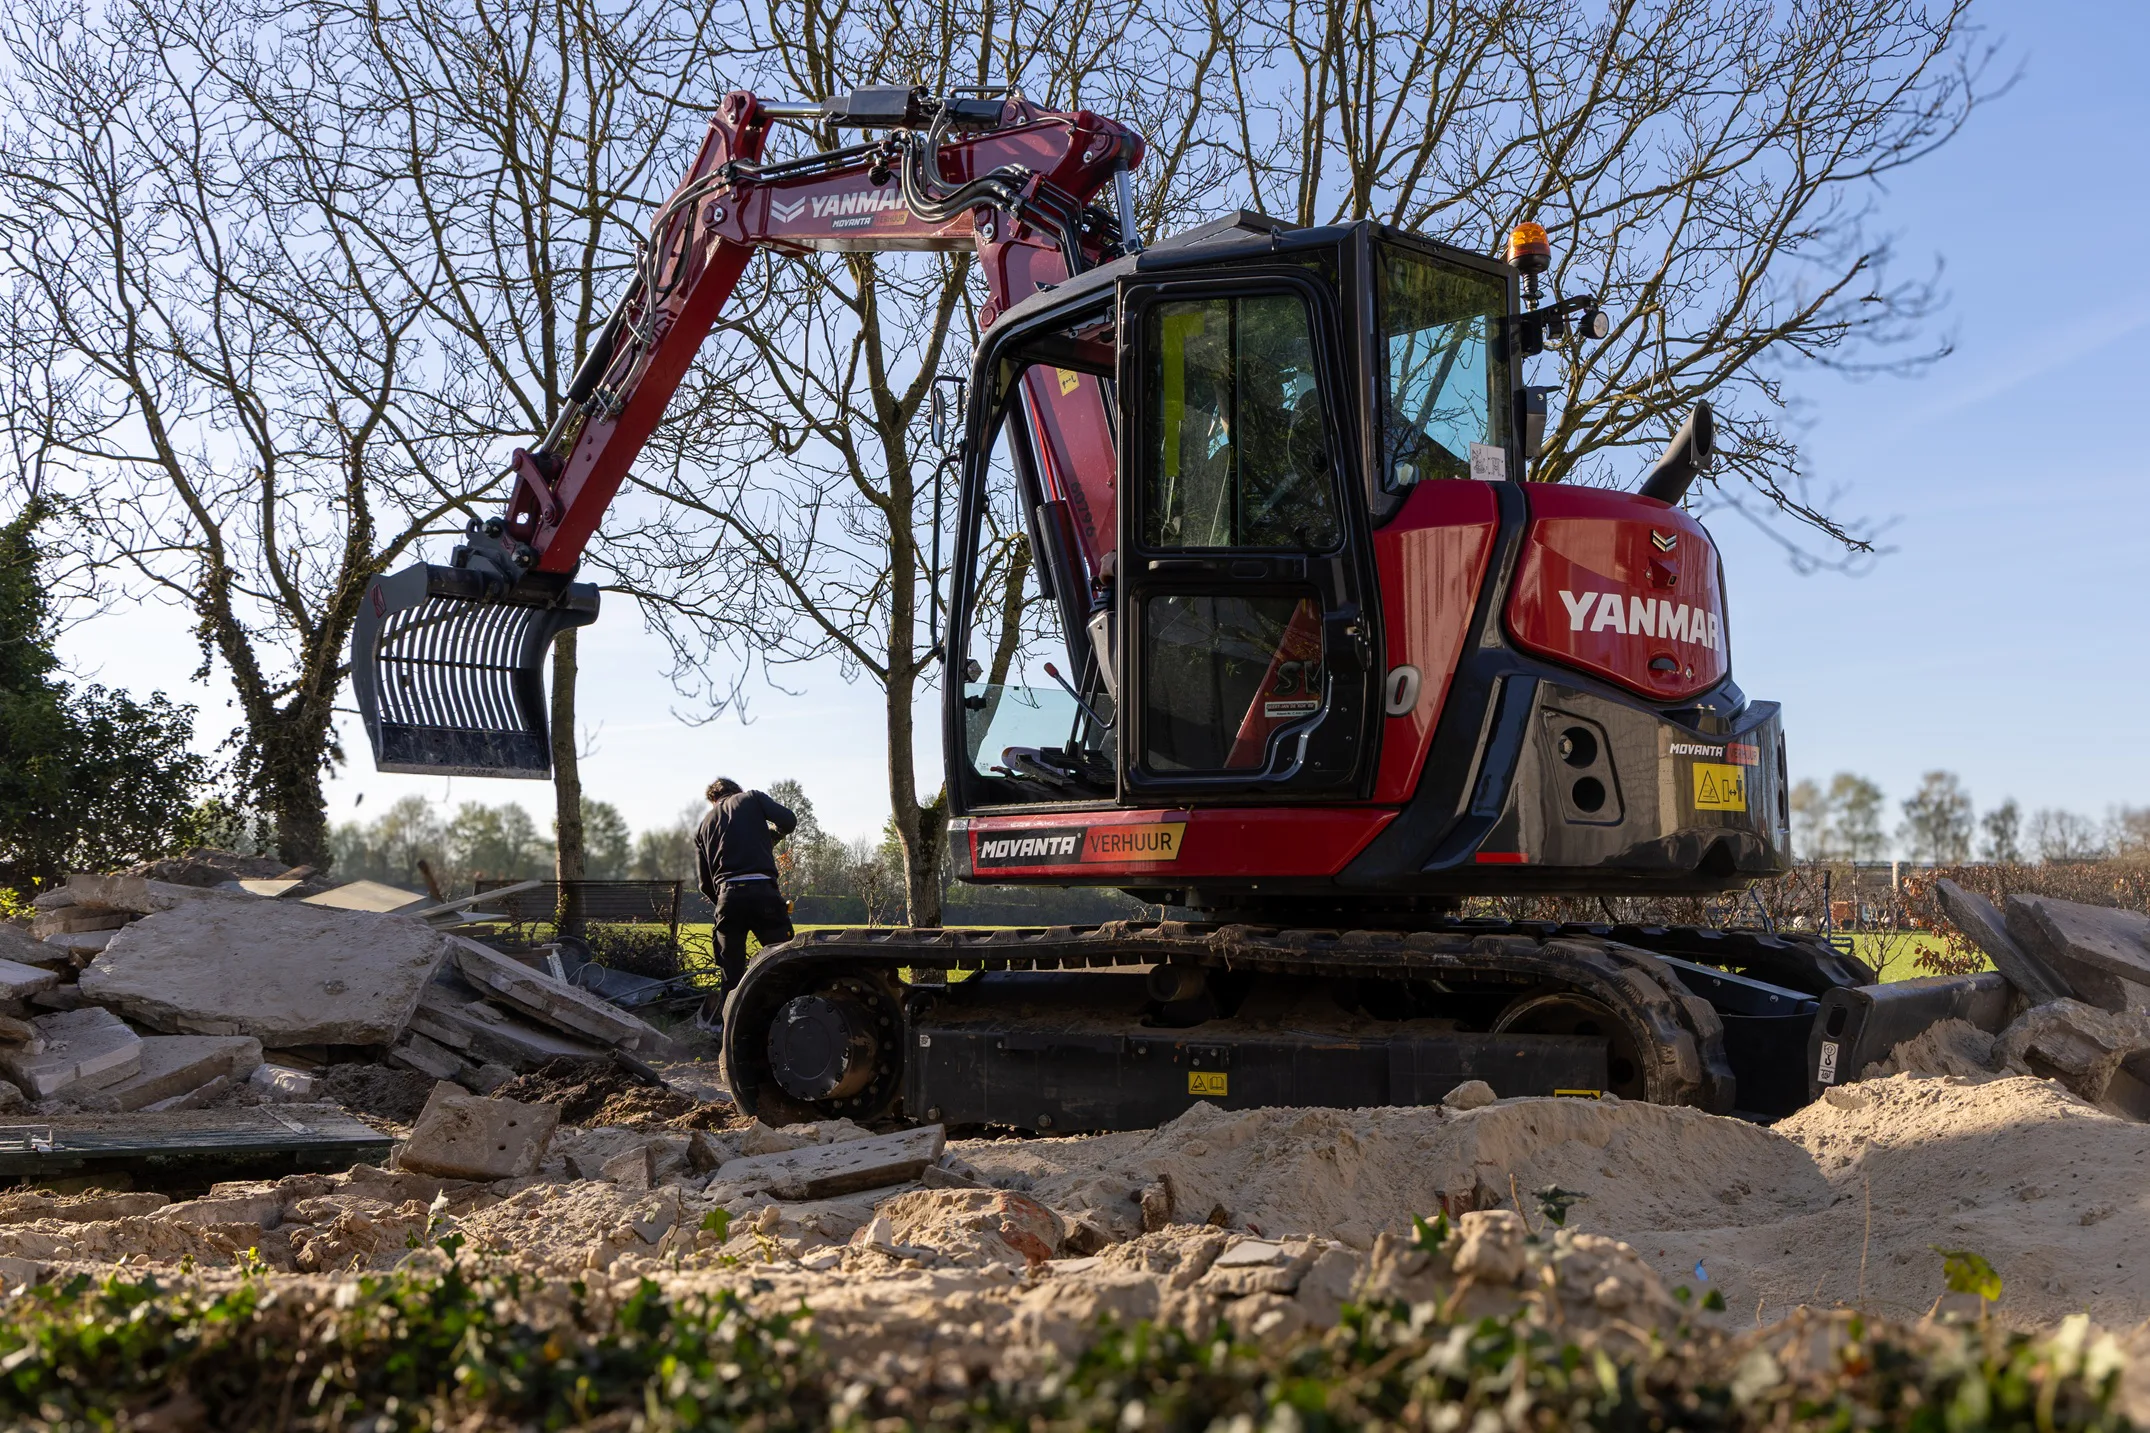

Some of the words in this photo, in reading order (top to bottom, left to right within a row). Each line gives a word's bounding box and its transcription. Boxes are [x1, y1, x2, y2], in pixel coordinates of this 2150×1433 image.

[832, 217, 871, 228] MOVANTA
[1558, 590, 1720, 651] YANMAR
[1669, 743, 1723, 757] MOVANTA
[981, 837, 1076, 859] MOVANTA
[1090, 832, 1172, 852] VERHUUR
